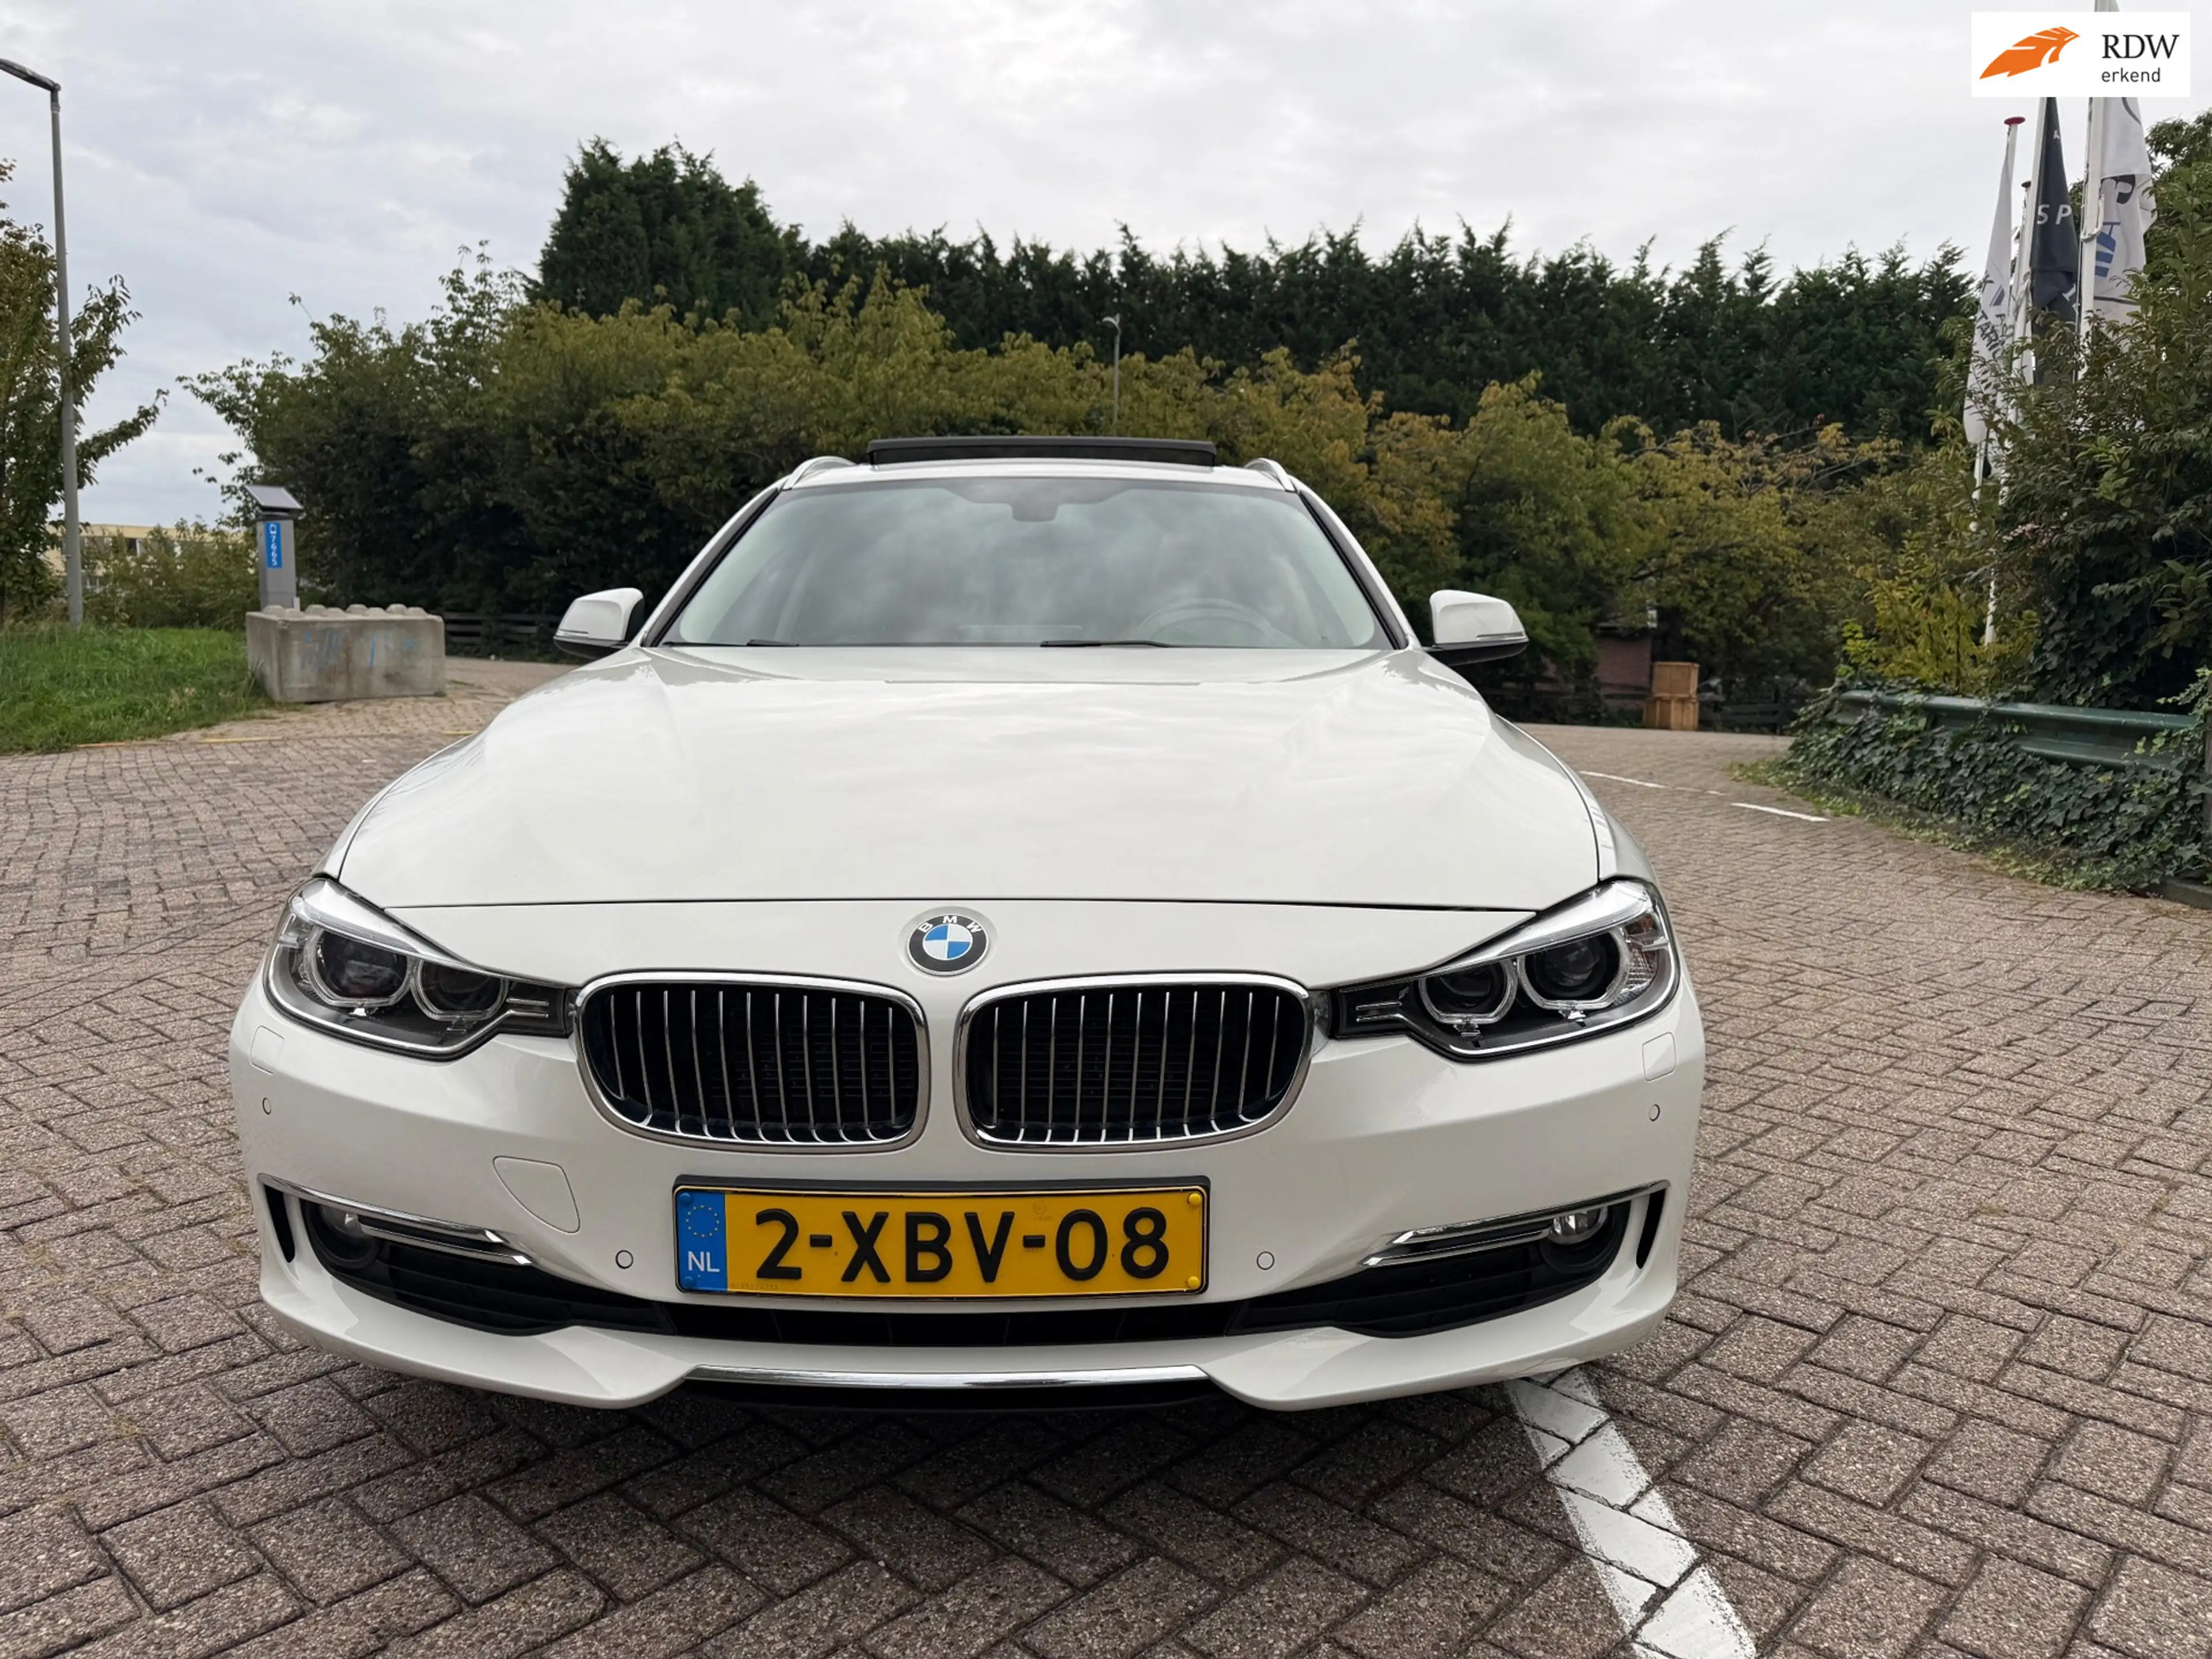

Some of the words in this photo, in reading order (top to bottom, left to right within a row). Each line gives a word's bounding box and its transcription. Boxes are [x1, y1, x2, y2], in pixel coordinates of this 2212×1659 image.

[918, 915, 983, 933] BMW
[755, 1207, 1169, 1283] 2-XBV-08
[688, 1251, 720, 1272] NL
